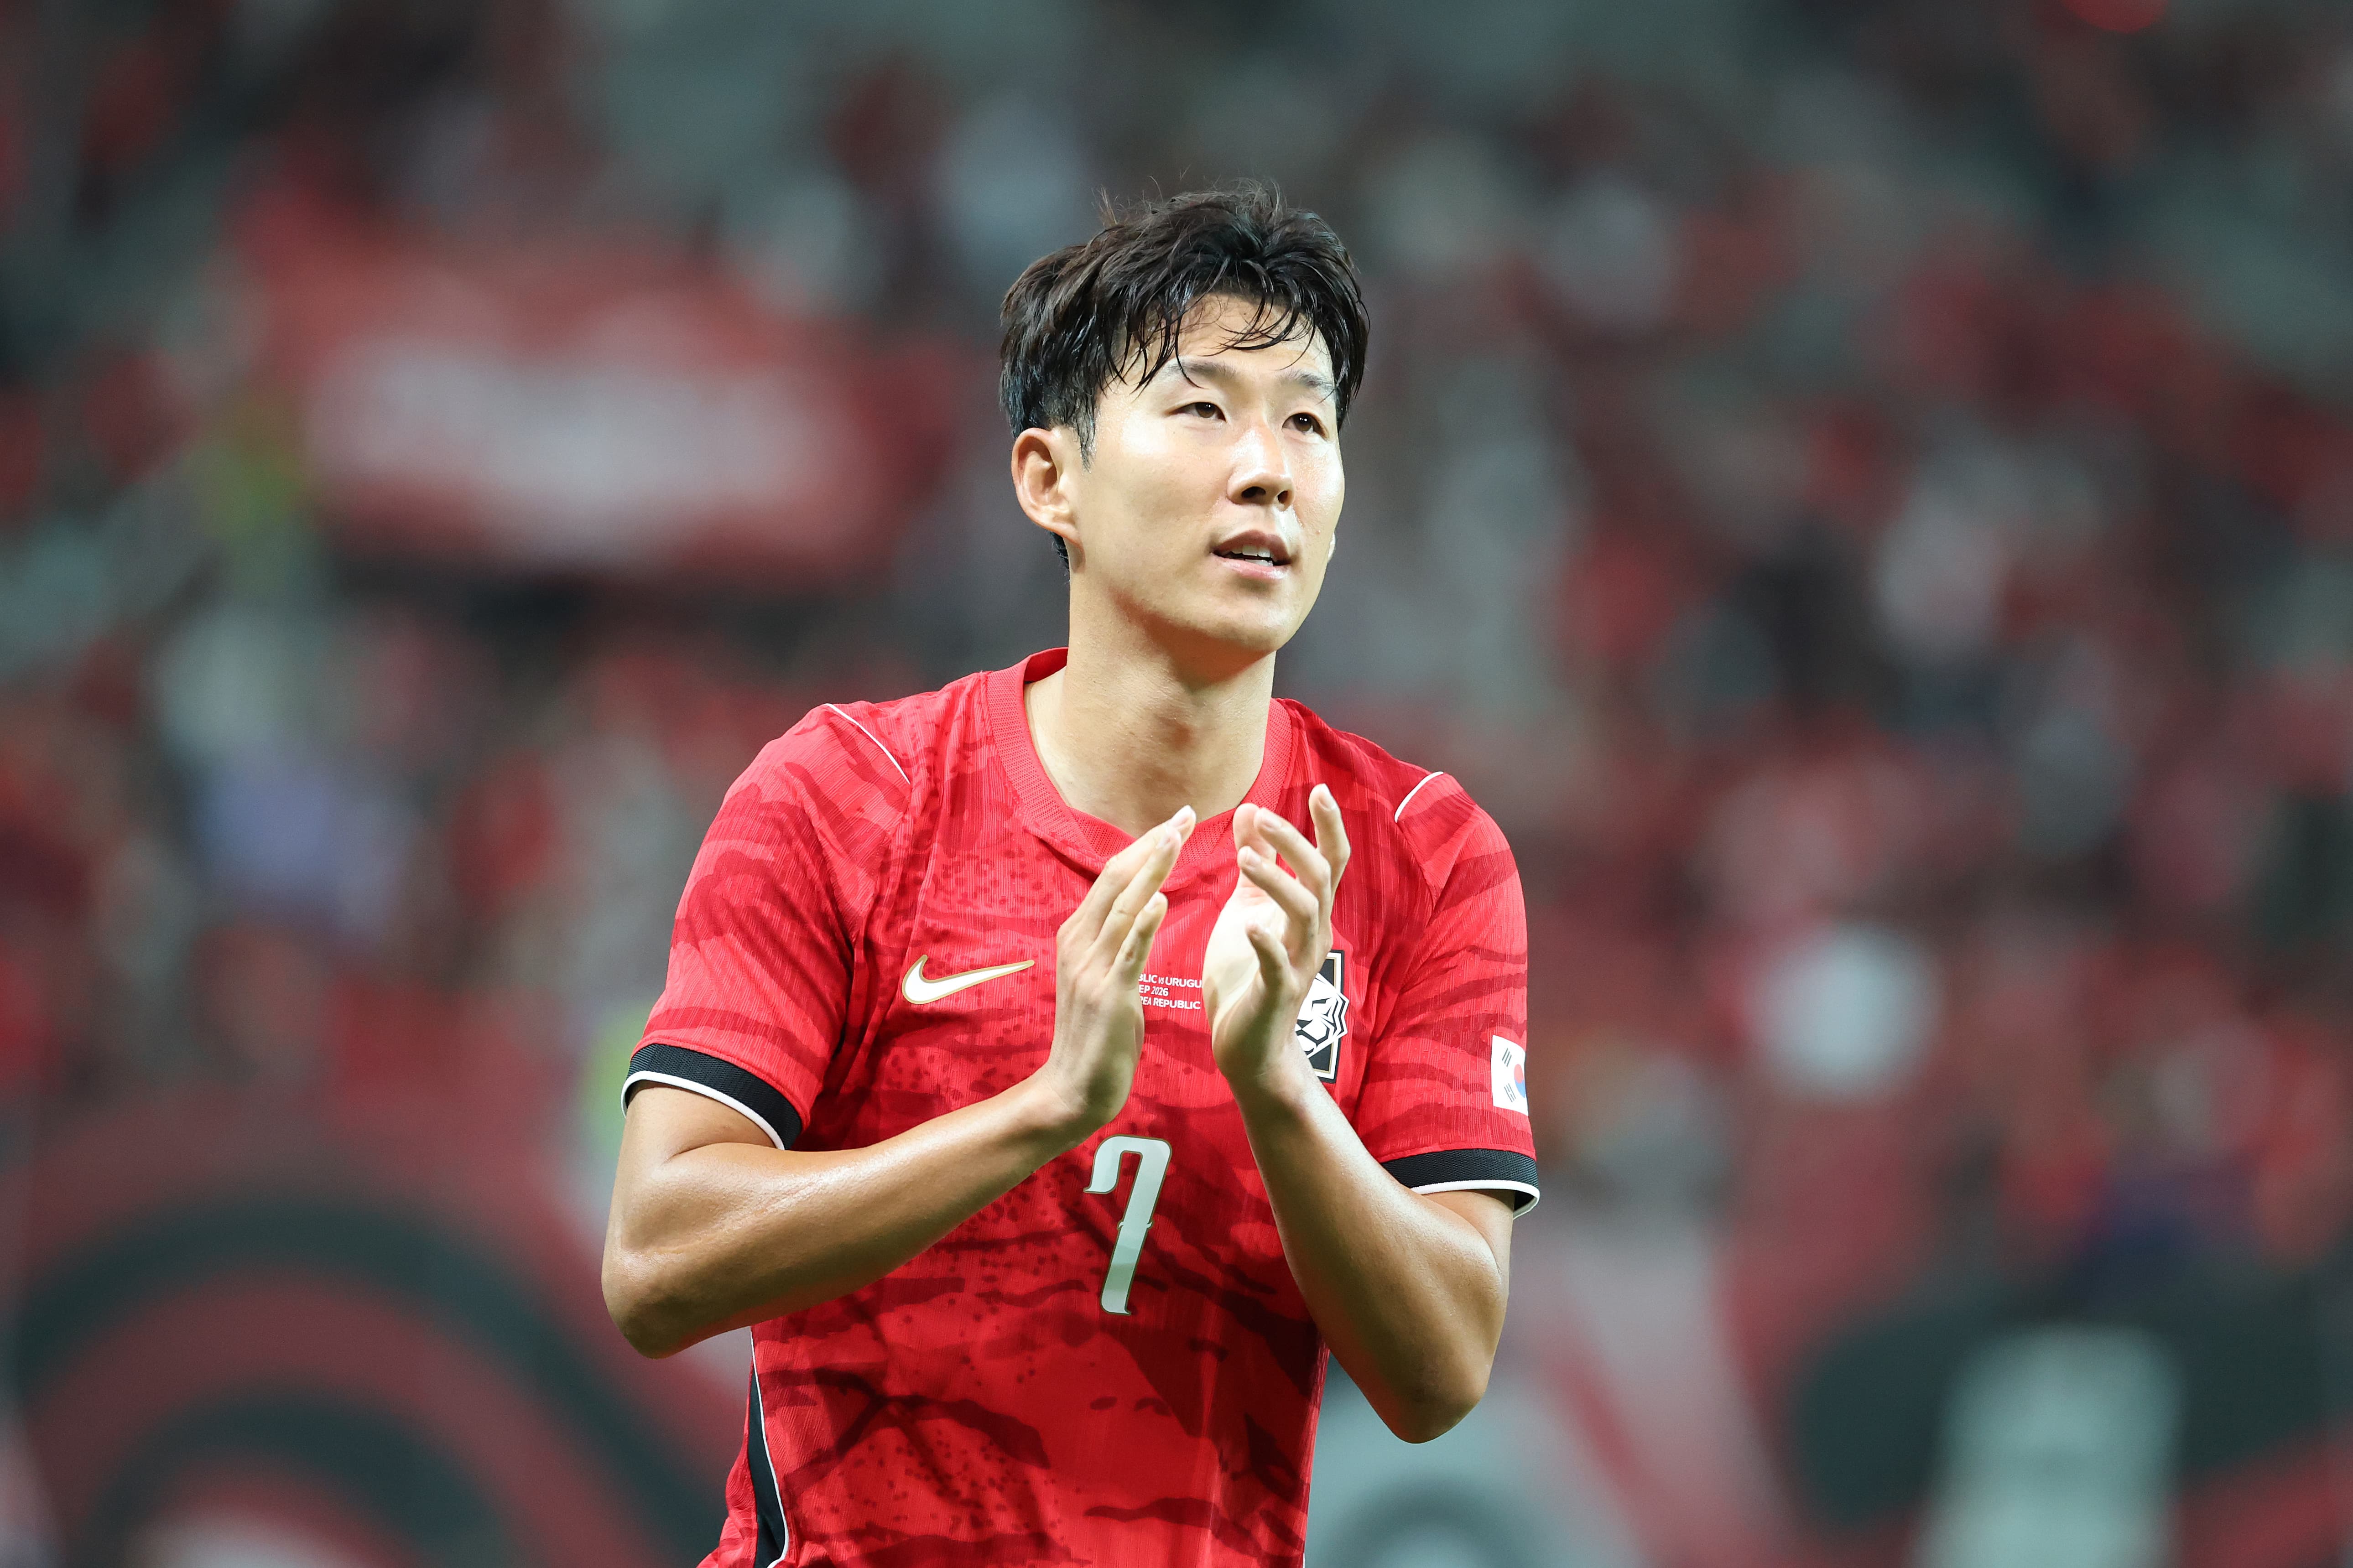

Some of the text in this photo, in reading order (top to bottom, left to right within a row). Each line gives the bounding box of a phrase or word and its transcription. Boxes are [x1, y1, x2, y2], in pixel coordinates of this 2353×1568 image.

[1138, 973, 1157, 983] BLIC
[1165, 976, 1203, 988] URUGU
[1139, 984, 1169, 996] EP 2026
[1153, 998, 1201, 1009] REPUBLIC
[1083, 1134, 1172, 1315] 7
